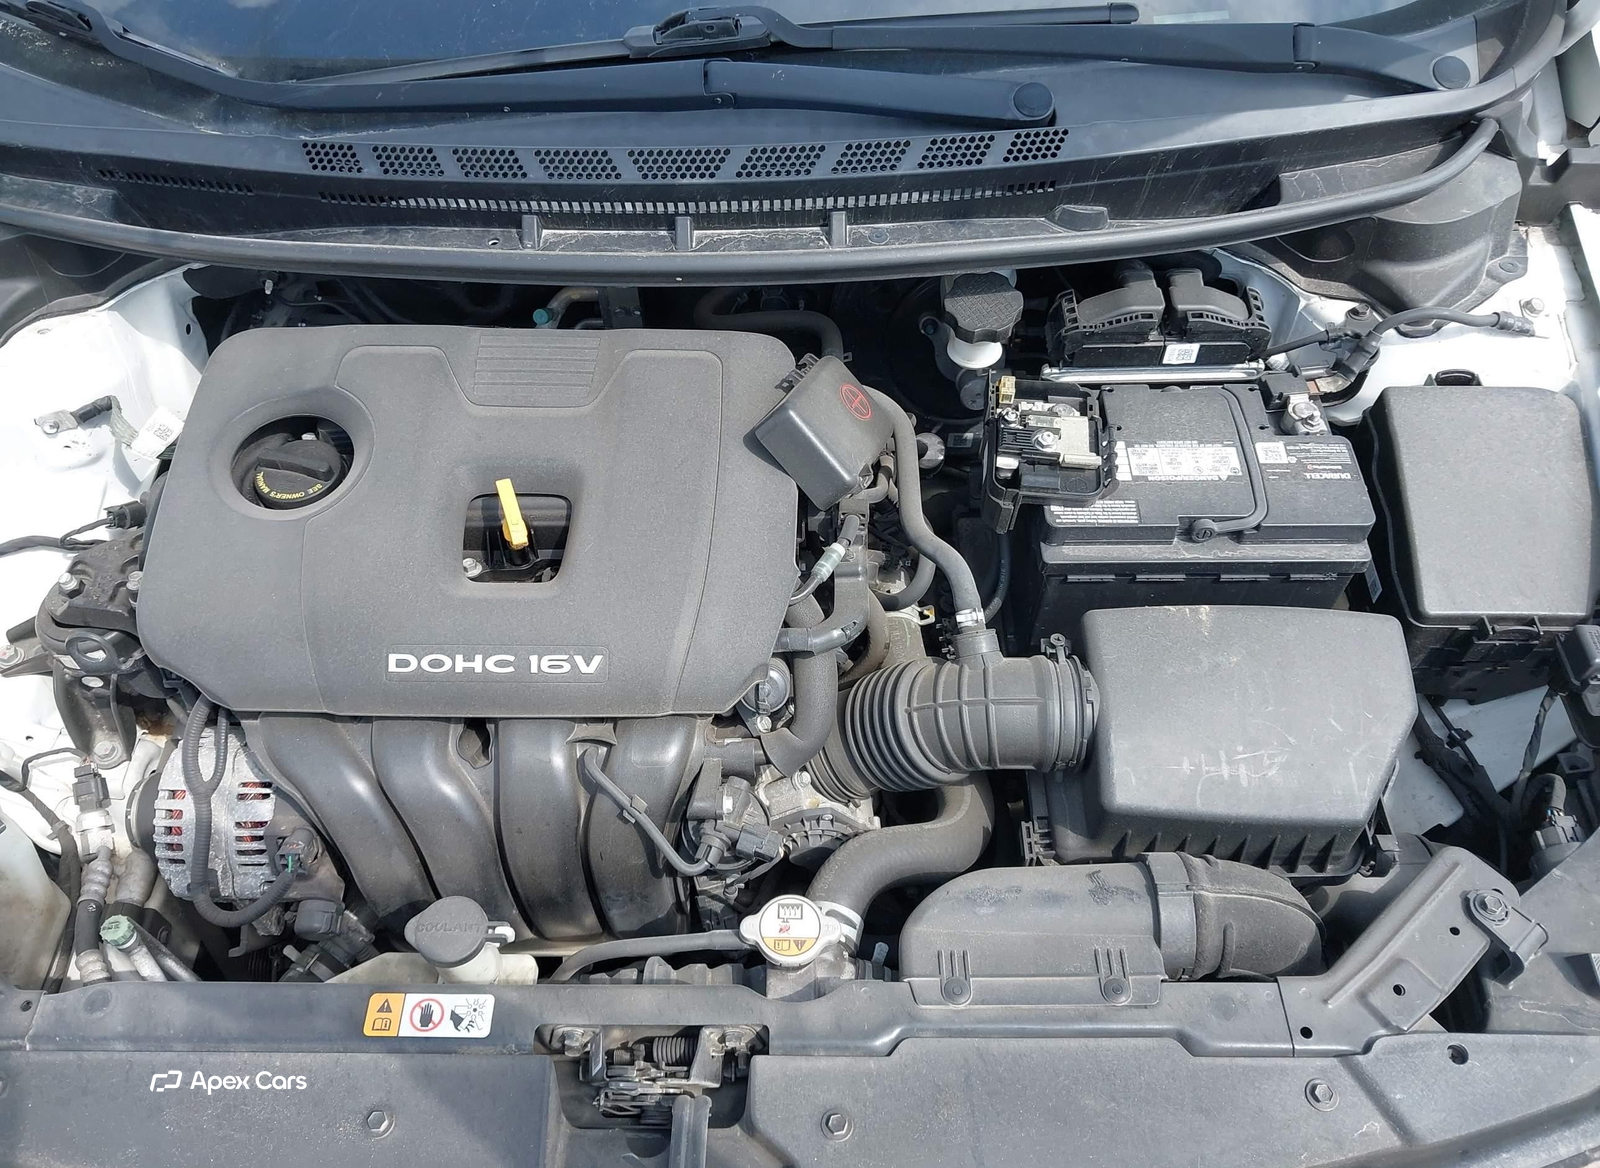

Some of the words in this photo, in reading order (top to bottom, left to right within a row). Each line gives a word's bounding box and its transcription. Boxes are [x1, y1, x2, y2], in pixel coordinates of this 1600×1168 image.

[1303, 472, 1351, 480] DURACELL
[256, 471, 272, 494] MANUAL
[306, 483, 323, 495] SEE
[269, 491, 305, 500] OWNER'S
[388, 653, 516, 674] DOHC
[529, 654, 604, 674] 16V
[417, 922, 481, 934] COOLANT
